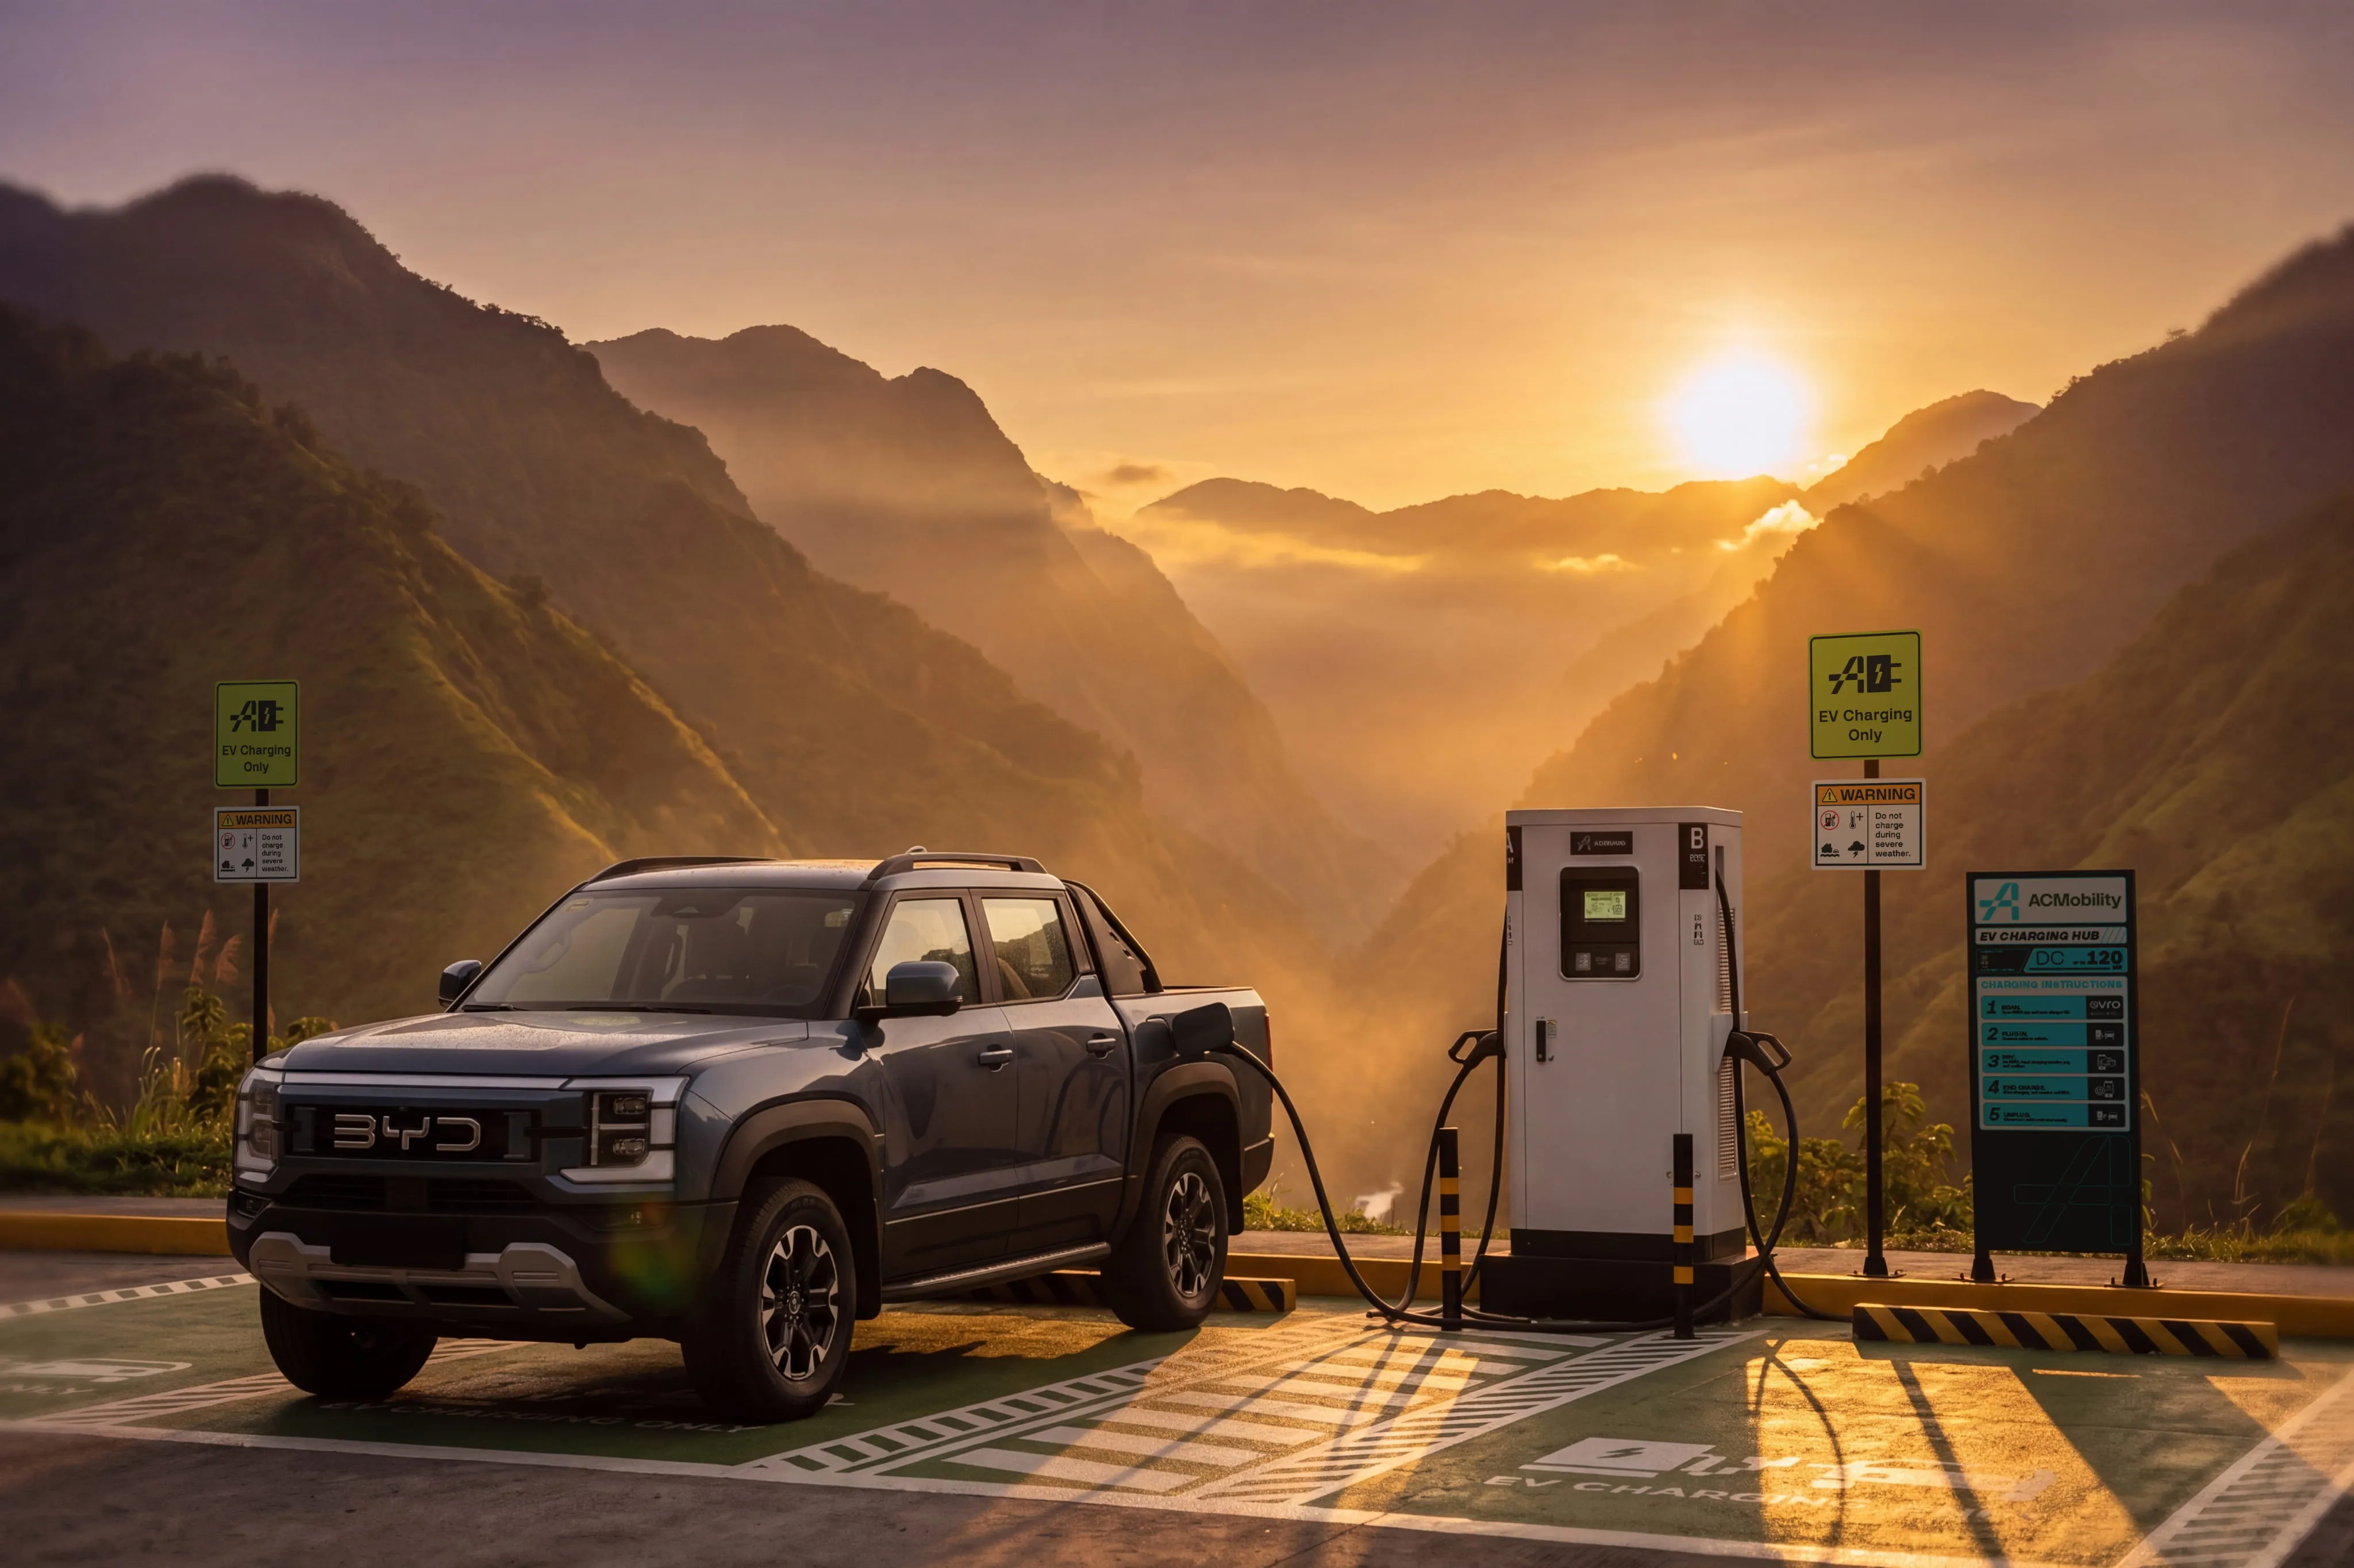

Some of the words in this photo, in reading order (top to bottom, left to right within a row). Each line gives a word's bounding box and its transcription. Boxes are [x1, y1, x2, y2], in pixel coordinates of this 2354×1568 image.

[1819, 710, 1838, 723] EV
[1843, 708, 1912, 723] Charging
[1848, 729, 1882, 743] Only
[222, 745, 237, 756] EV
[240, 745, 291, 757] Charging
[244, 761, 269, 774] Only
[1841, 788, 1915, 801] WARNING
[236, 814, 292, 825] WARNING
[1875, 822, 1904, 830] charge
[1690, 827, 1704, 849] B
[1875, 831, 1901, 840] during
[1875, 849, 1911, 858] weather.
[2028, 892, 2122, 909] ACMobility
[1980, 931, 1997, 941] EV
[1999, 931, 2069, 941] CHARGING
[2072, 930, 2099, 941] HUB
[2036, 950, 2065, 965] DC
[2087, 950, 2124, 965] 120
[1981, 981, 2038, 989] CHARGING
[2041, 980, 2123, 989] INSTRUCTIONS
[1986, 1000, 1997, 1015] 1
[1987, 1027, 1999, 1041] 2
[1987, 1054, 1999, 1068] 3
[1987, 1080, 1999, 1094] 4
[1988, 1107, 2001, 1122] 5
[334, 1114, 480, 1151] BYD
[0, 1384, 97, 1394] NLY
[634, 1420, 767, 1433] ONLY
[1483, 1475, 1563, 1488] EV
[1573, 1481, 1871, 1509] CHARGING
